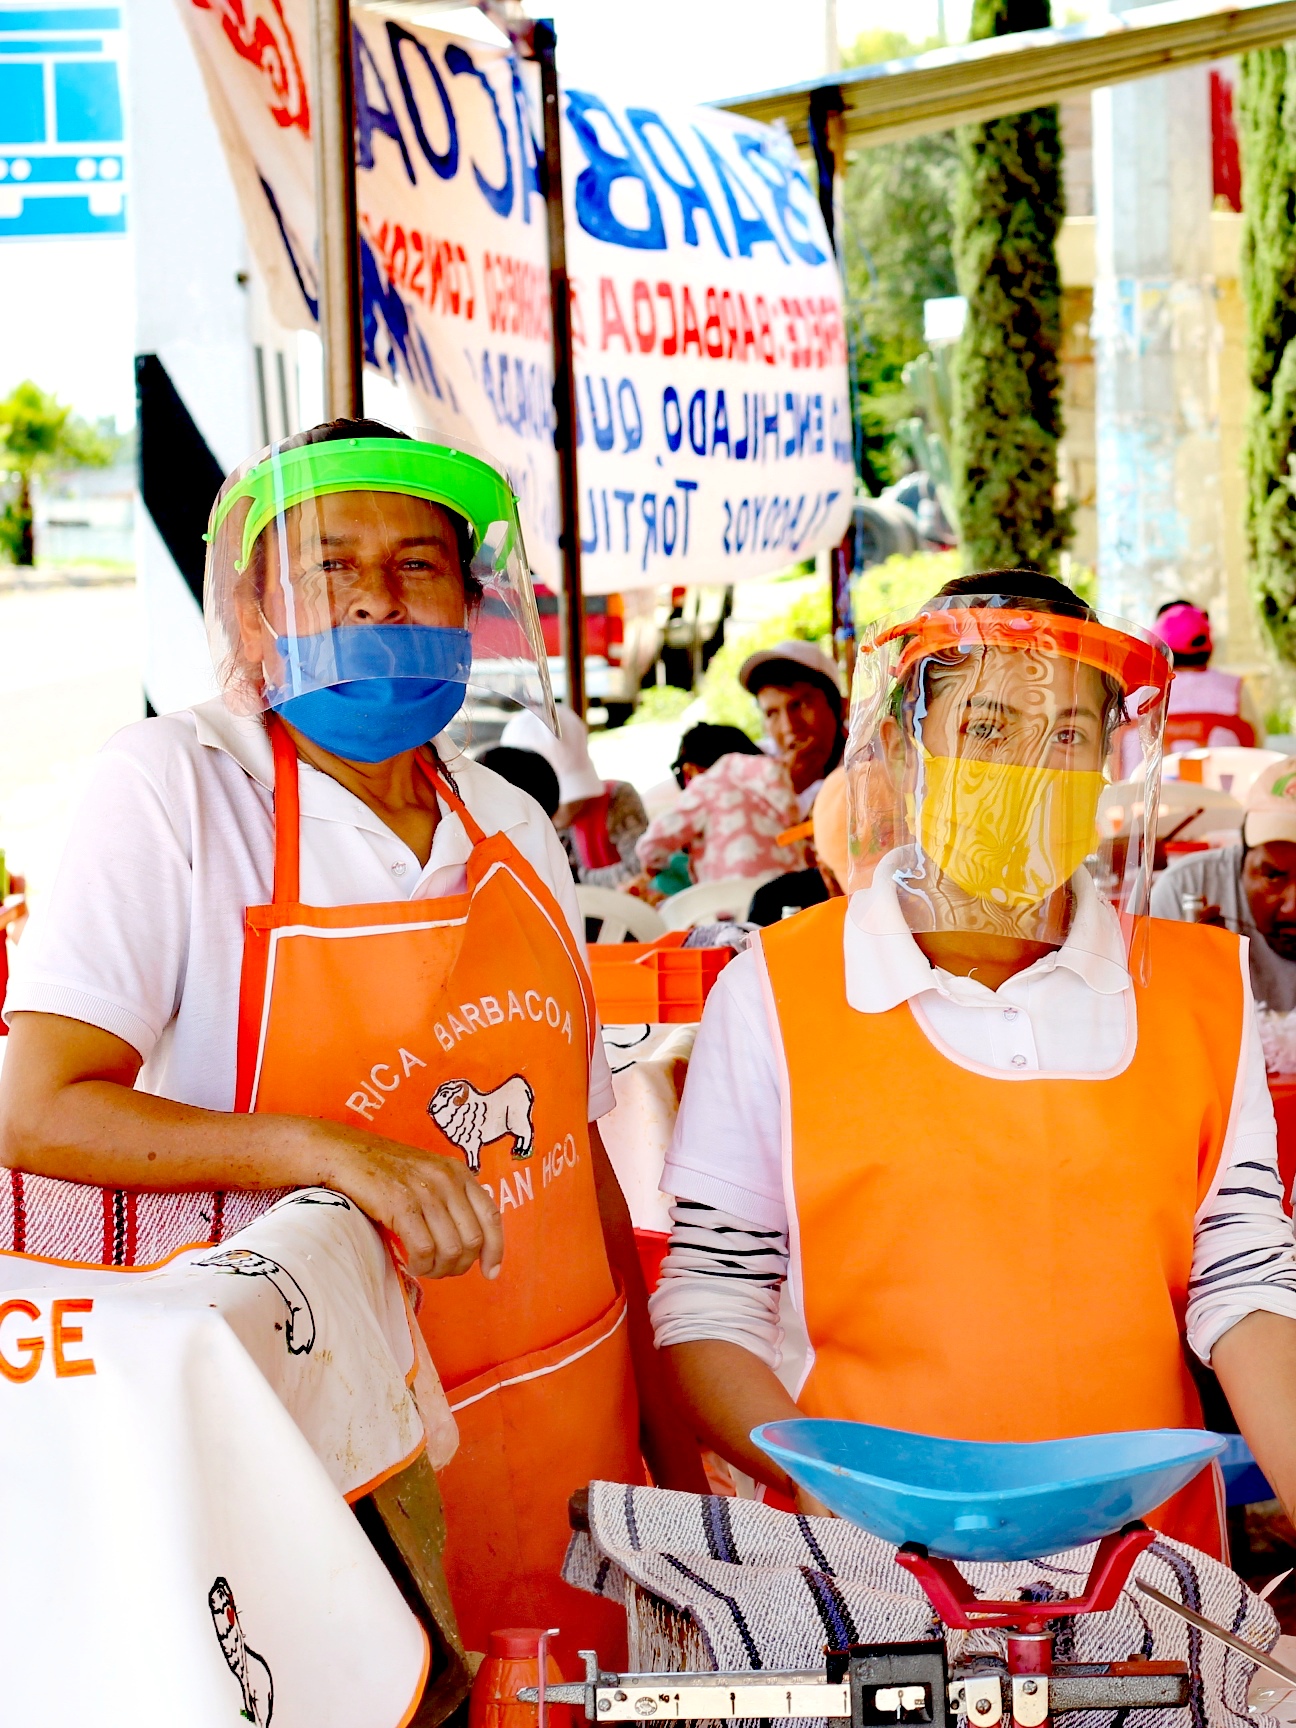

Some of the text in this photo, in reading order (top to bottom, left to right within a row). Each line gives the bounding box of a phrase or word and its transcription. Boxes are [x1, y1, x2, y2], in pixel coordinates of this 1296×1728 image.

[345, 989, 573, 1121] RICA BARBACOA
[658, 1694, 670, 1703] Kg
[673, 1693, 680, 1701] 4
[730, 1692, 736, 1700] 3
[786, 1691, 792, 1700] 2
